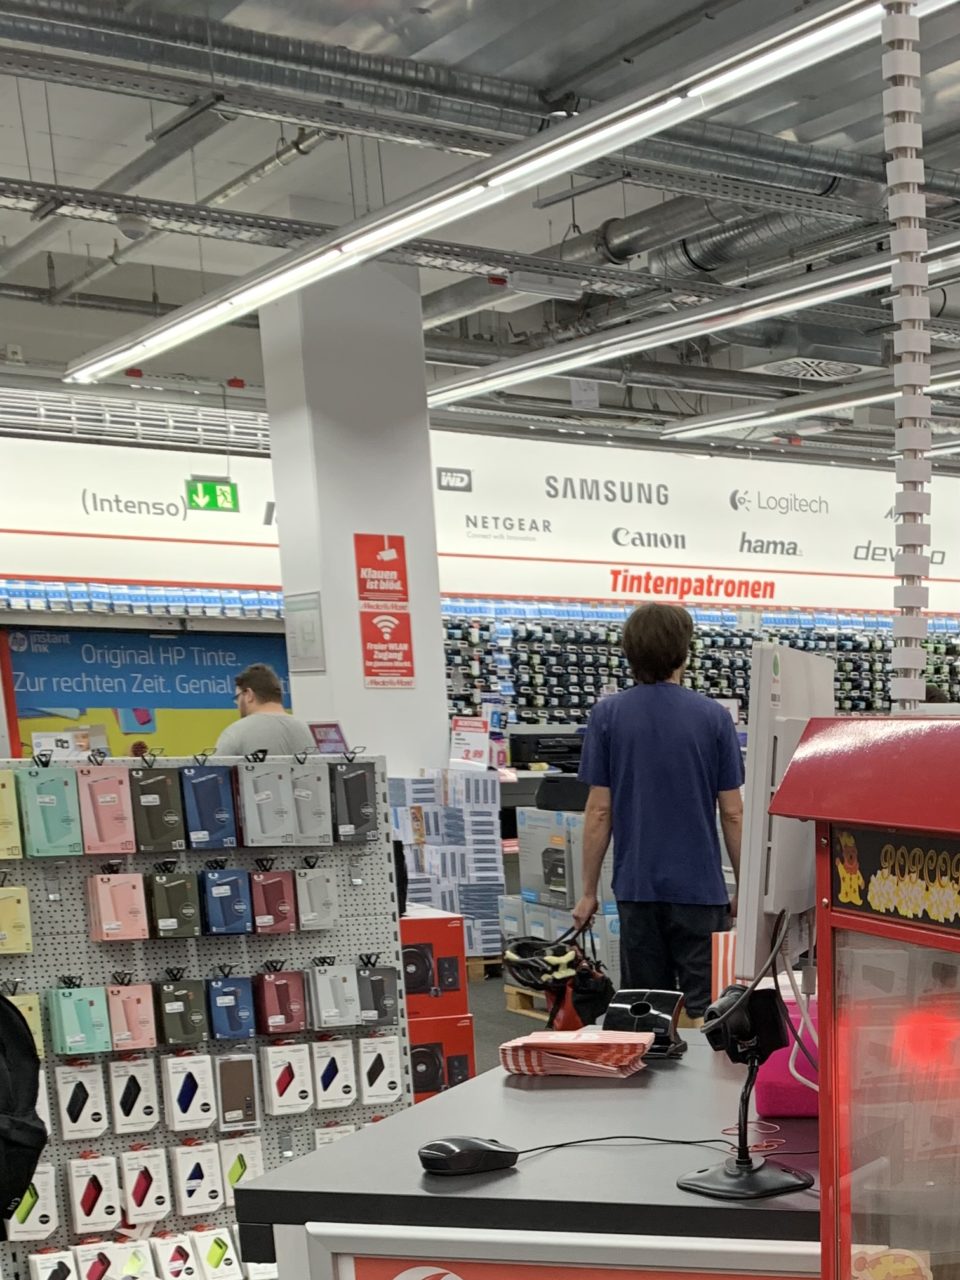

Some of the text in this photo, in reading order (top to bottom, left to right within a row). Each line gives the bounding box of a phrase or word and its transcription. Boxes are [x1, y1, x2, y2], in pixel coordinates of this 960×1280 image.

[441, 472, 469, 488] WD
[545, 475, 669, 506] SAMSUNG
[757, 491, 829, 515] Logitech
[465, 515, 552, 533] NETGEAR
[611, 527, 686, 550] Canon
[739, 531, 798, 556] hama
[854, 540, 946, 565] devo
[610, 569, 775, 600] Tintenpatronen
[81, 643, 241, 668] Original HP Tinte.
[13, 671, 231, 695] Zur rechten Zeit. Genial
